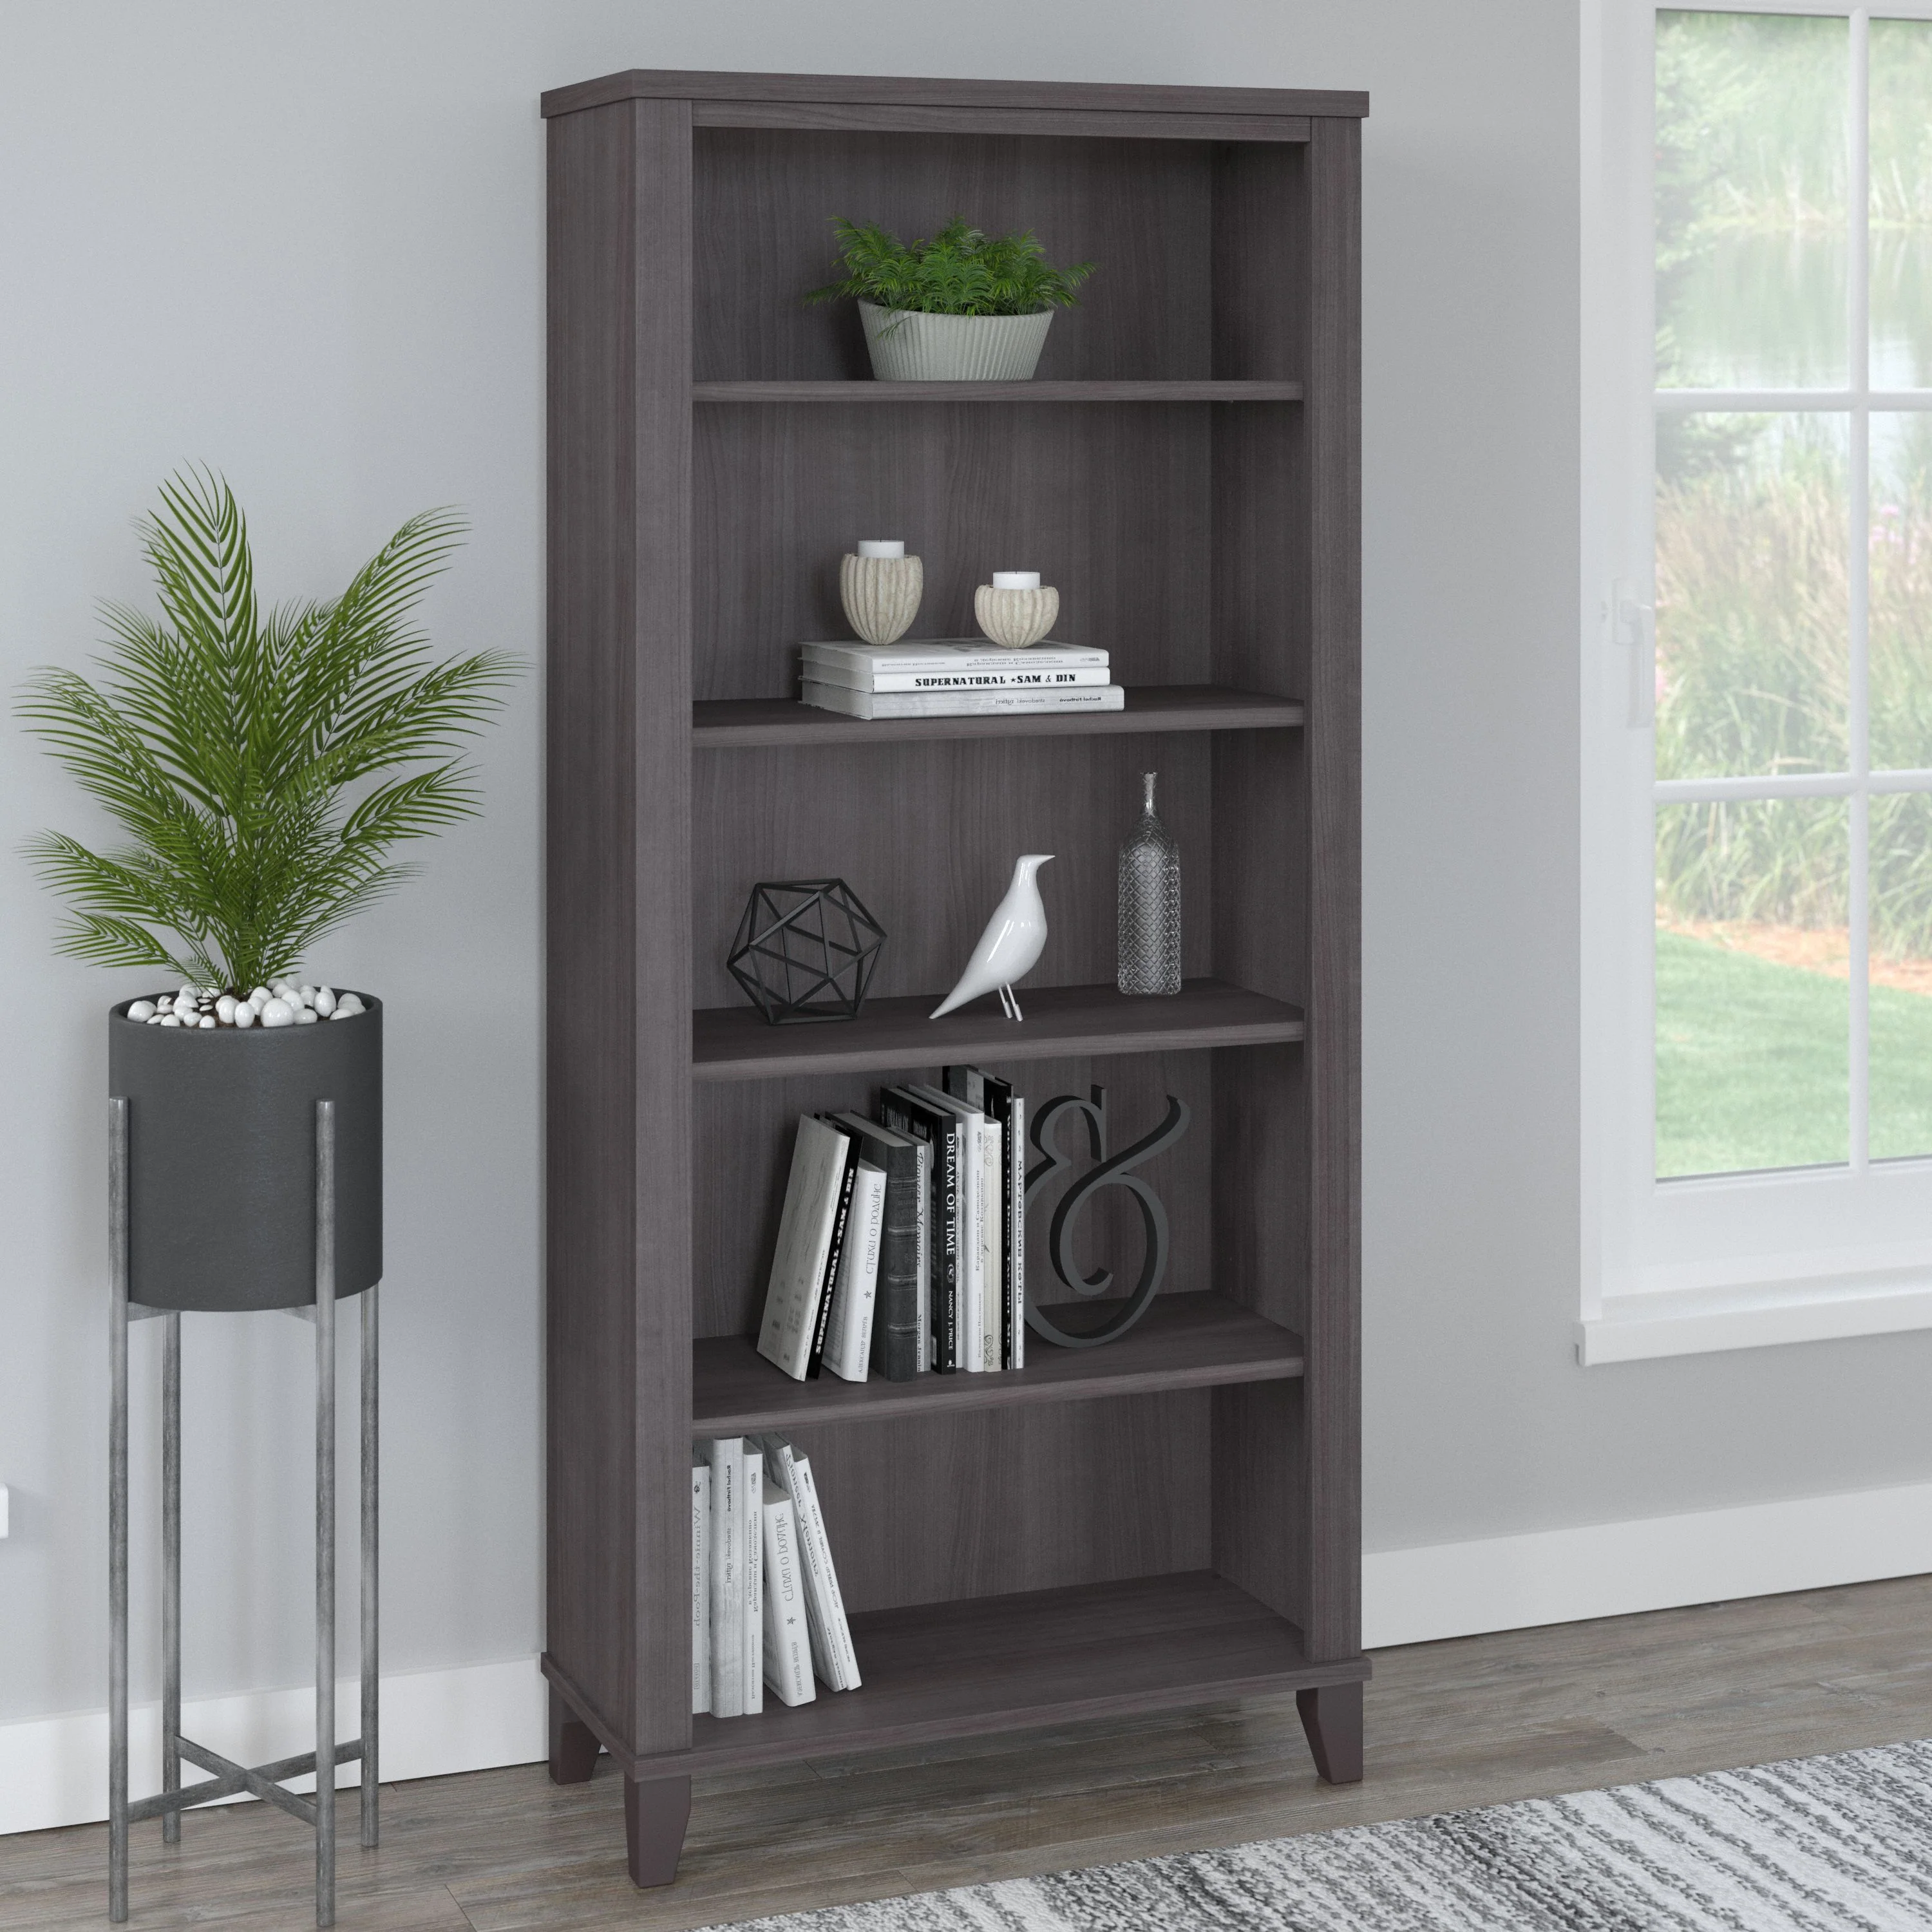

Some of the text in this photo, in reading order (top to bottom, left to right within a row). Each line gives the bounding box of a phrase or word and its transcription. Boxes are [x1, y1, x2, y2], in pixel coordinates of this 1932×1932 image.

[915, 674, 1075, 687] SUPERNATURAL SAM & DIN
[946, 1133, 956, 1256] DREAM OF TIME
[815, 1248, 840, 1355] SUPERNATURAL
[846, 1168, 854, 1192] DIN
